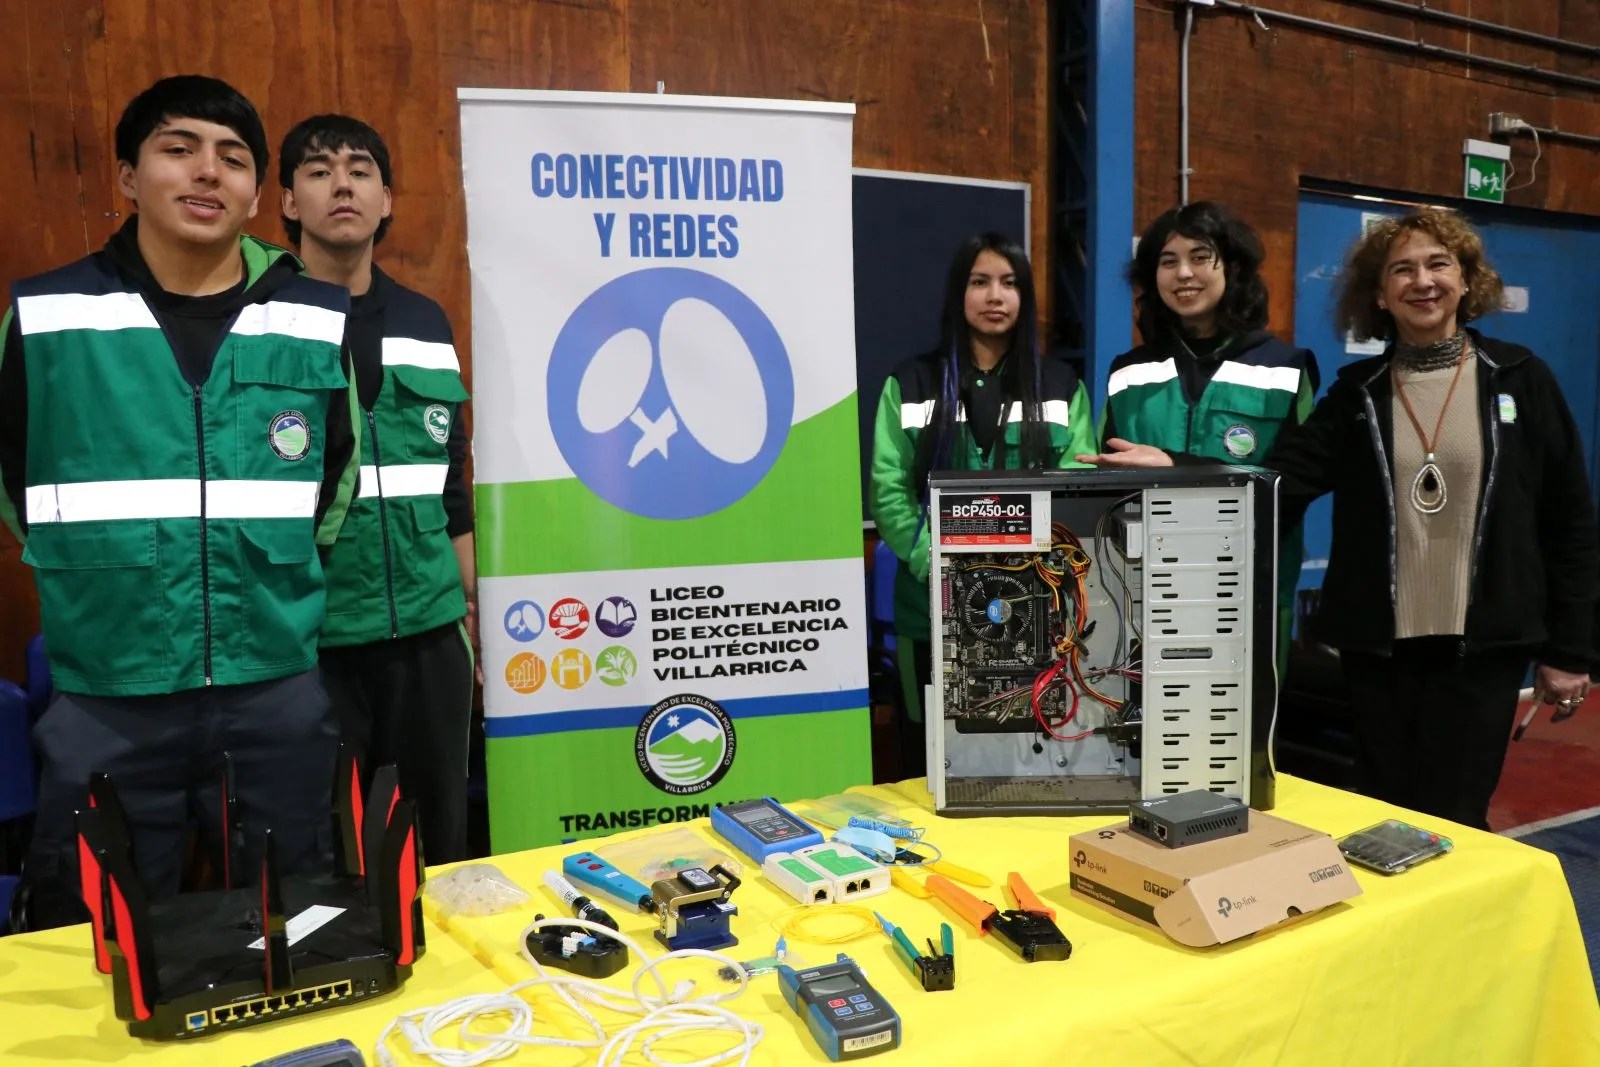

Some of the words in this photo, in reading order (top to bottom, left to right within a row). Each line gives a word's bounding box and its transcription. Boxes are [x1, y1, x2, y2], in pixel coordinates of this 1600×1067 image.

[531, 152, 784, 202] CONECTIVIDAD
[593, 212, 616, 258] Y
[629, 212, 740, 259] REDES
[952, 504, 1025, 518] BCP450-OC
[650, 585, 725, 602] LICEO
[651, 598, 842, 622] BICENTENARIO
[652, 627, 687, 642] DE
[691, 617, 849, 639] EXCELENCIA
[653, 638, 820, 662] POLITÉCNICO
[653, 658, 808, 681] VILLARRICA
[669, 696, 681, 705] DE
[681, 696, 723, 718] EXCELENCIA
[637, 701, 669, 749] BICENTENARIO
[637, 750, 650, 773] LICEO
[664, 780, 712, 794] VILLARRICA
[1233, 895, 1258, 910] tp-link
